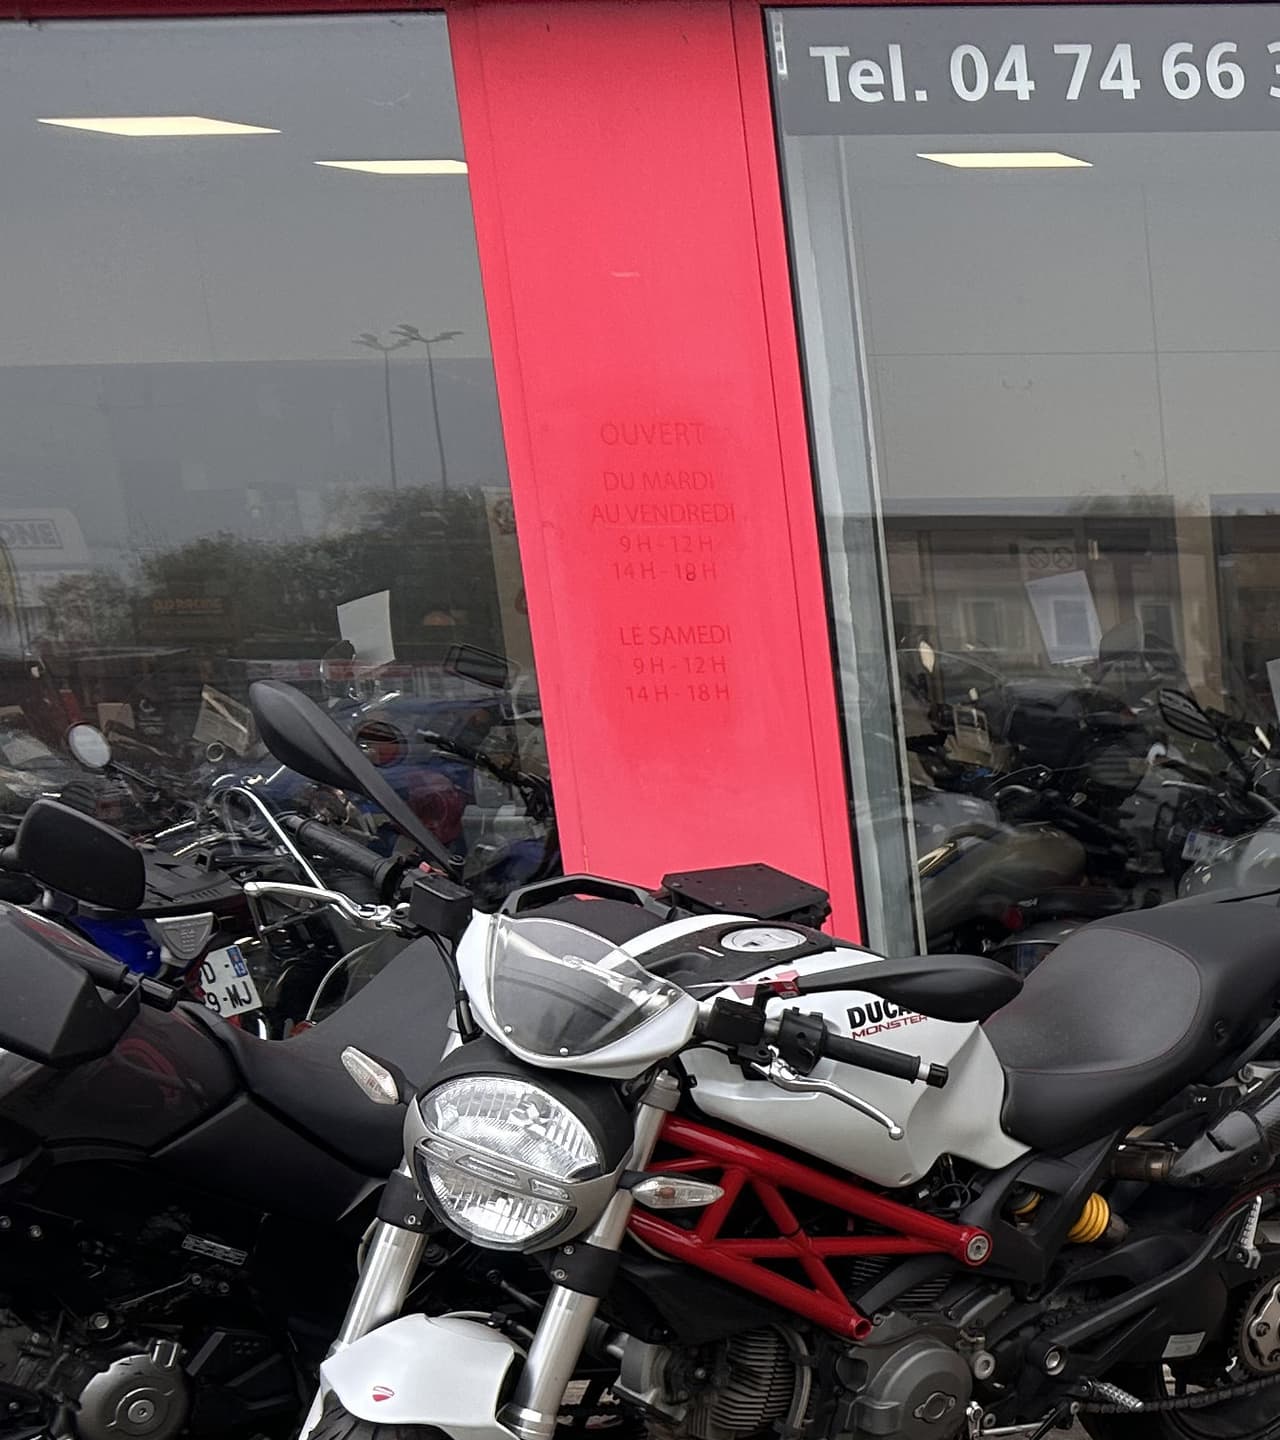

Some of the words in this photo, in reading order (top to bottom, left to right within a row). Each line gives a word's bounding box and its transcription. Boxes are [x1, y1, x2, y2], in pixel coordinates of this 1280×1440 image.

[810, 45, 928, 102] Tel.
[950, 44, 1035, 101] 04
[1054, 43, 1142, 100] 74
[1162, 42, 1247, 99] 66
[601, 422, 706, 445] OUVERT
[603, 471, 634, 492] DU
[643, 471, 713, 491] MARDI
[592, 504, 620, 524] AU
[625, 503, 735, 523] VENDREDI
[620, 626, 643, 646] LE
[649, 625, 732, 645] SAMEDI
